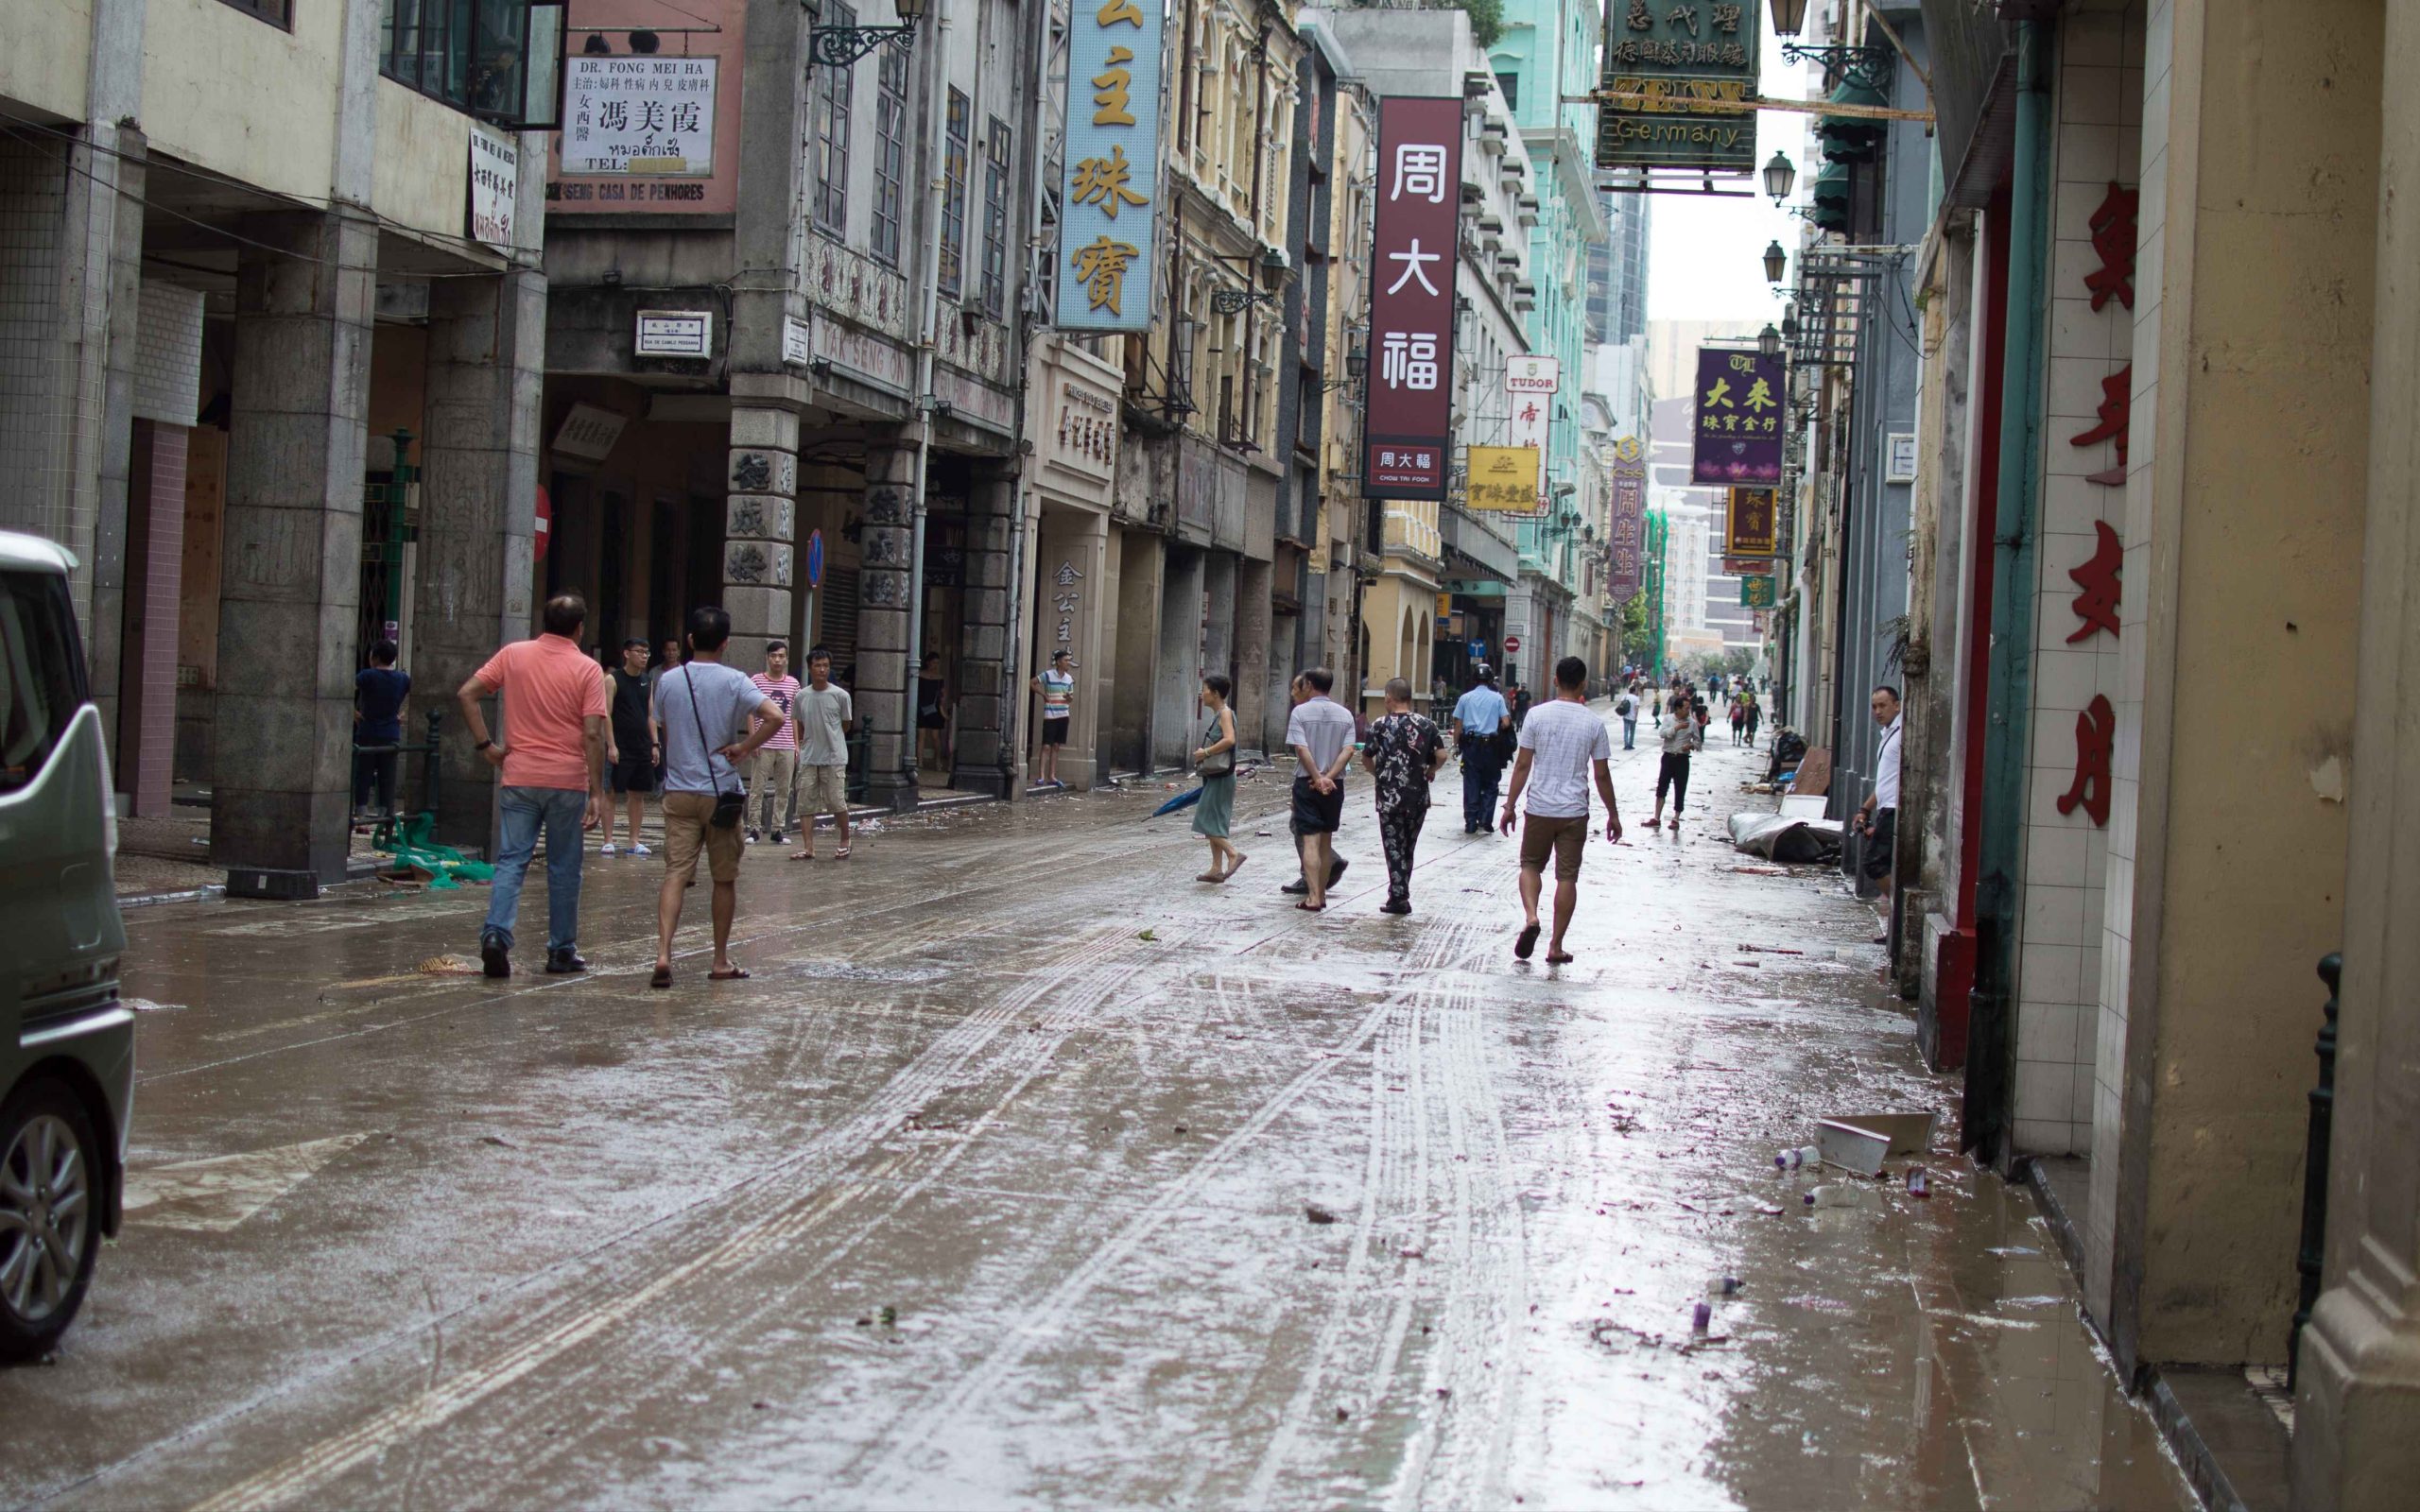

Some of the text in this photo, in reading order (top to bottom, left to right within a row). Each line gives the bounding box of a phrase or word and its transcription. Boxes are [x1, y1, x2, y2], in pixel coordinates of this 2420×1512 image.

[580, 61, 703, 75] DR. FONG MEI HA
[598, 100, 700, 133] 馮美霞
[1616, 118, 1739, 148] Germany
[585, 158, 628, 170] TEL:
[599, 183, 625, 200] CASA
[631, 183, 645, 200] DE
[649, 183, 704, 201] PENHORES
[1382, 144, 1447, 390] 周大福
[853, 335, 884, 375] SENG
[1511, 378, 1553, 388] TUDOR
[1380, 452, 1431, 469] 周大福
[1612, 468, 1644, 479] CSS
[1615, 489, 1639, 576] 周生生
